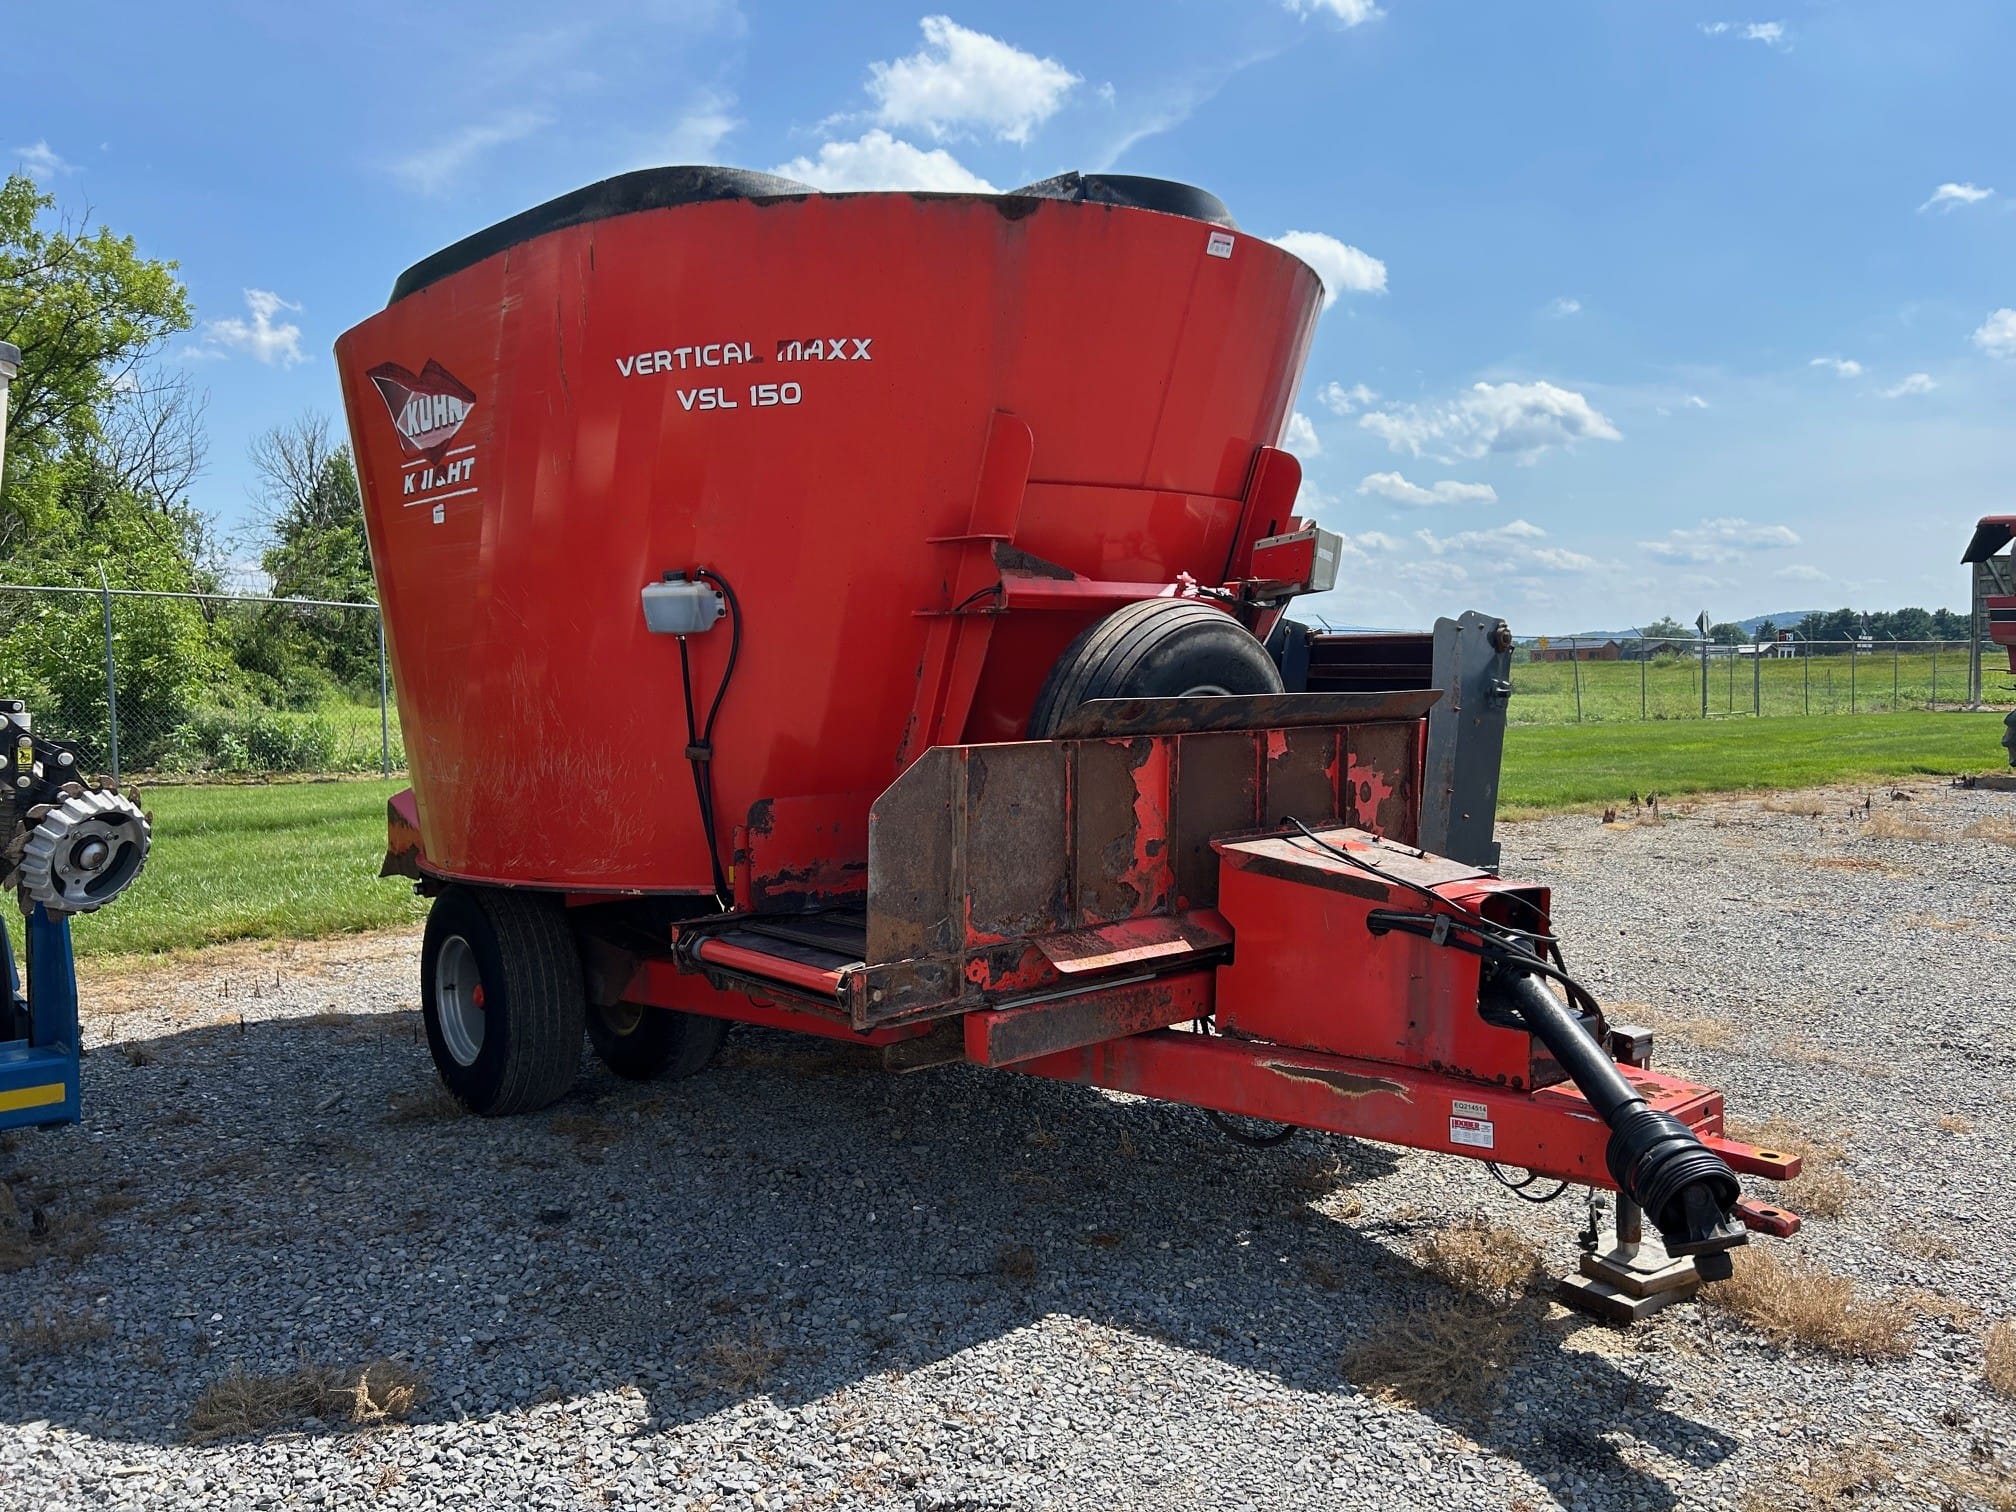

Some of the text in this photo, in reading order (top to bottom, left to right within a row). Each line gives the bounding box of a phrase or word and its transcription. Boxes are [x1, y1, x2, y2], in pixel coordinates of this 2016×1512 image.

[676, 382, 802, 411] VSL 150
[405, 394, 464, 438] KUHN
